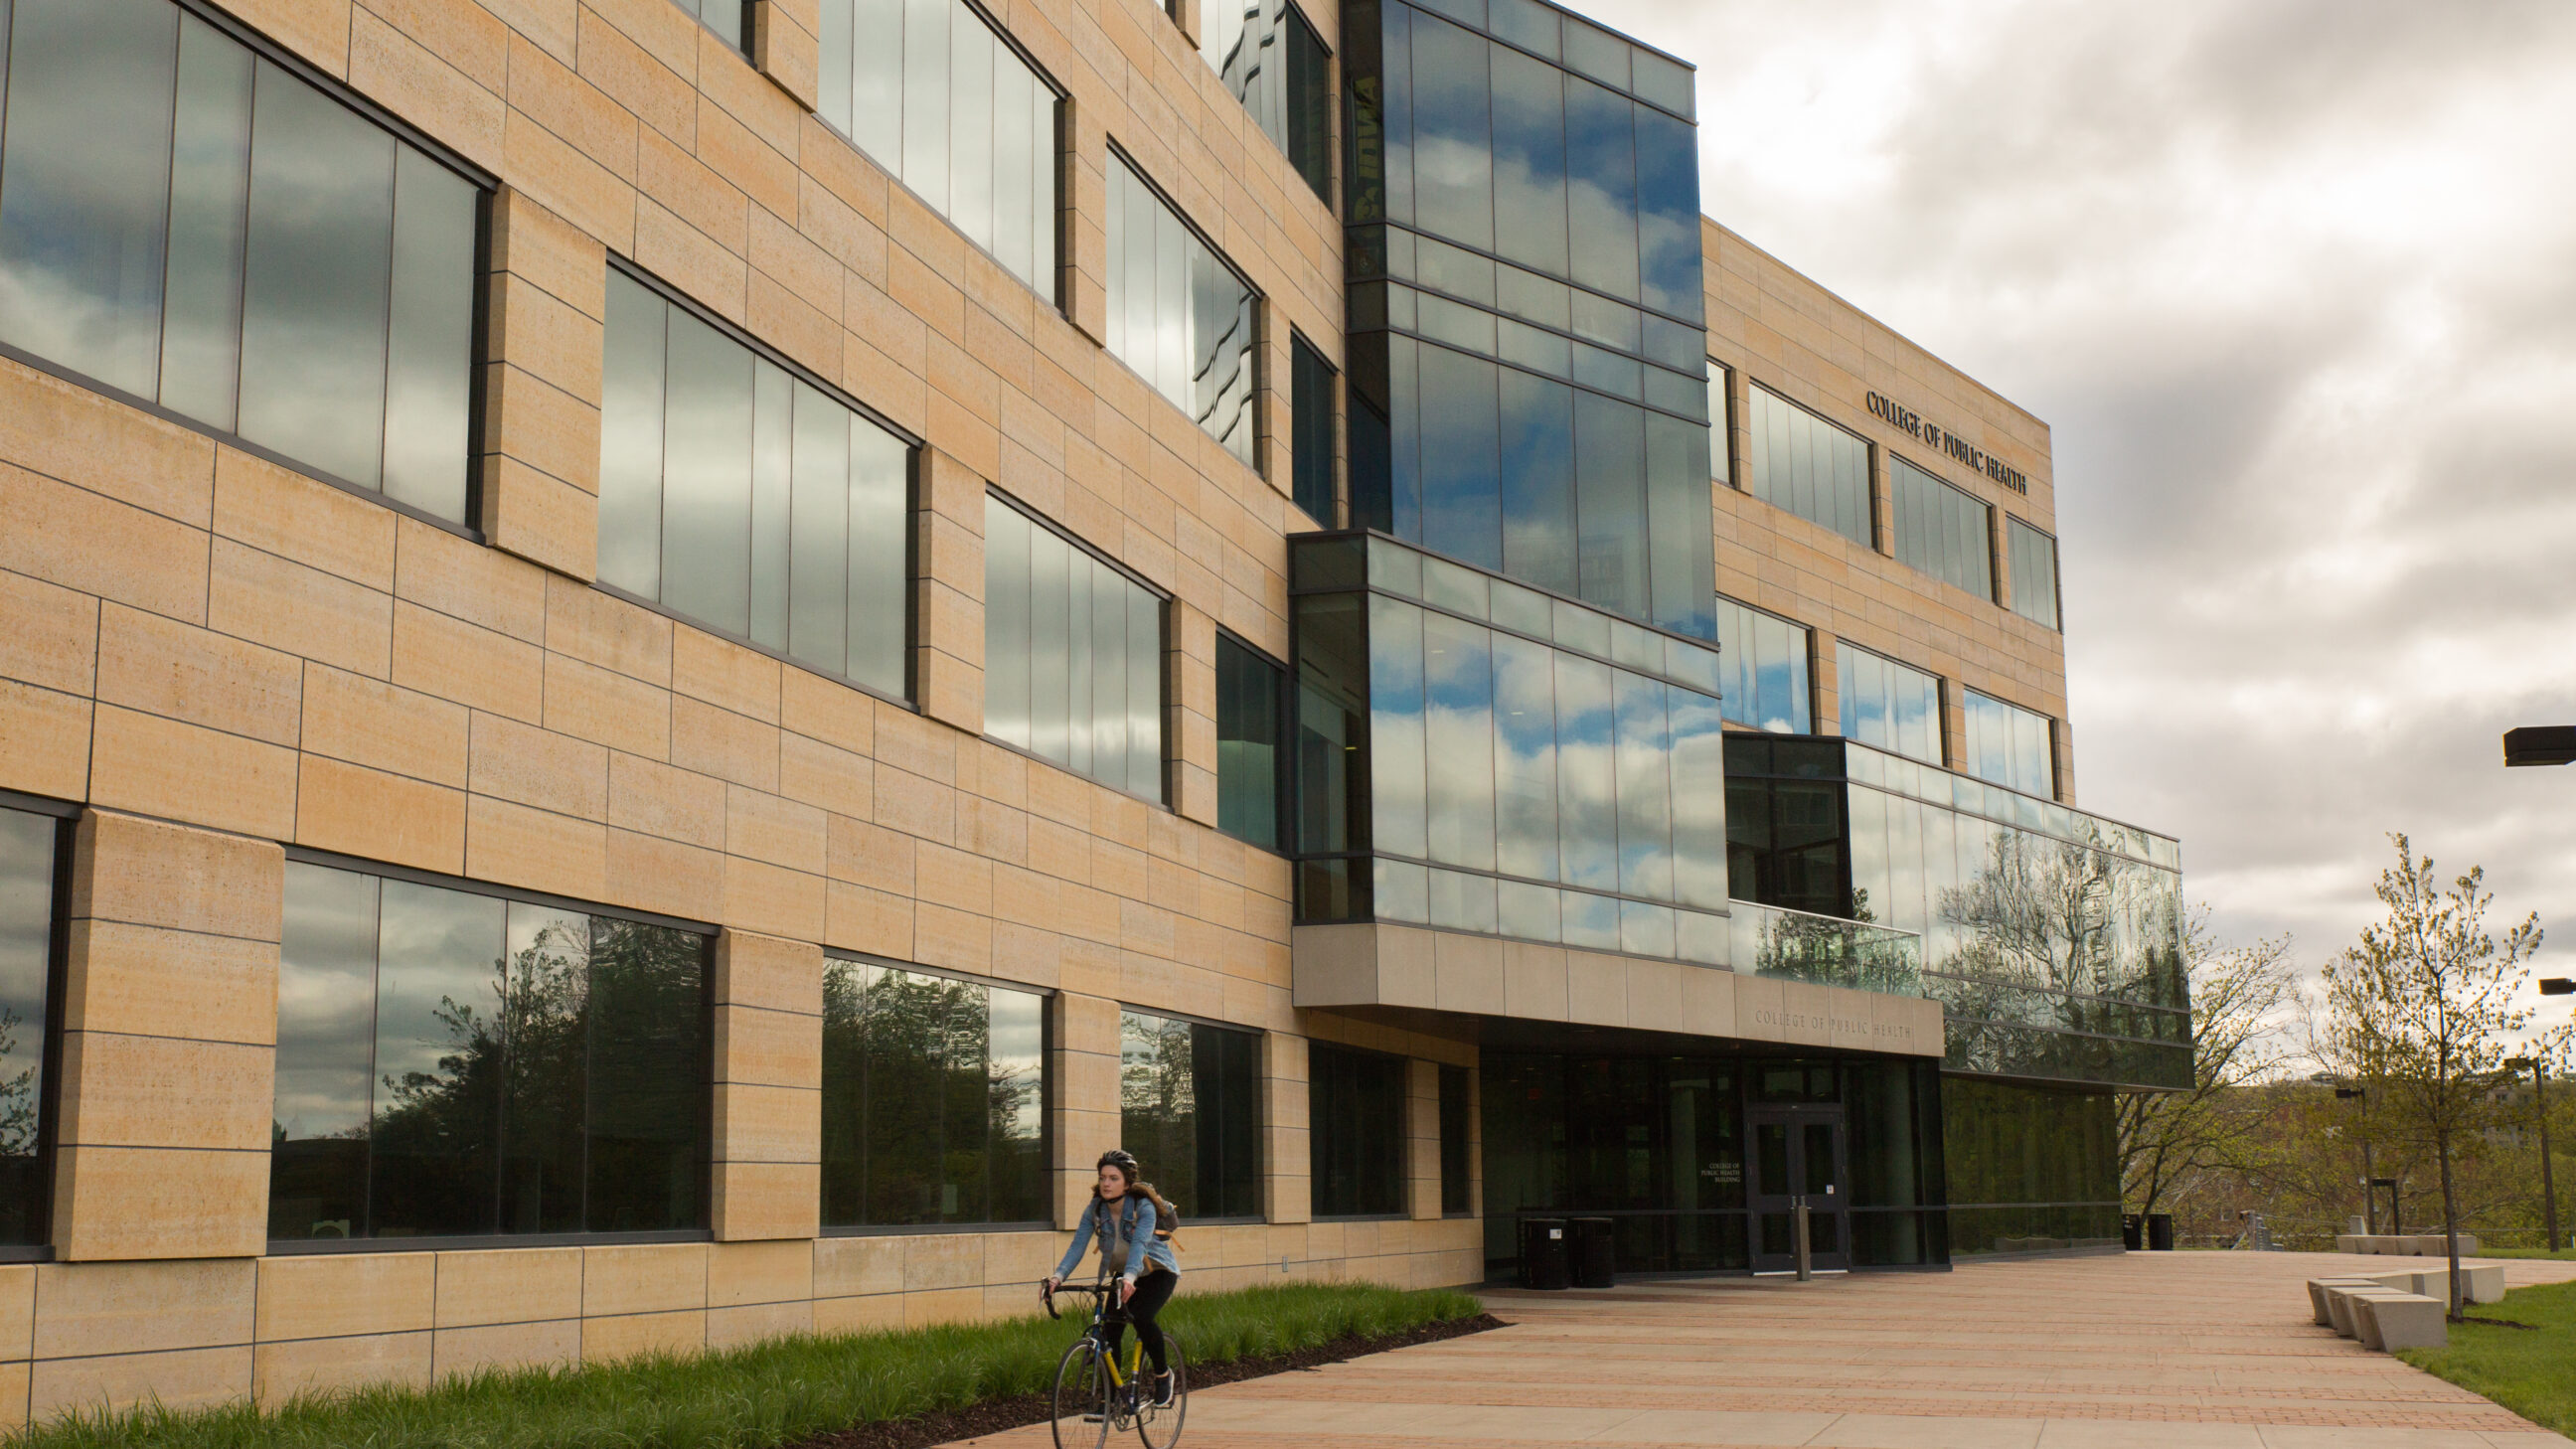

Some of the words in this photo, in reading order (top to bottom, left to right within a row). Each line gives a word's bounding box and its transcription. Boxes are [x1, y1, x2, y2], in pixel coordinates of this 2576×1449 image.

[1866, 391, 1921, 437] COLLEGE
[1924, 422, 1941, 447] OF
[1943, 431, 1984, 472] PUBLIC
[1986, 454, 2027, 495] HEALTH
[1755, 1010, 1805, 1028] COLLEGE
[1812, 1017, 1825, 1030] OF
[1831, 1019, 1867, 1034] PUBLIC
[1873, 1024, 1911, 1039] HEALTH
